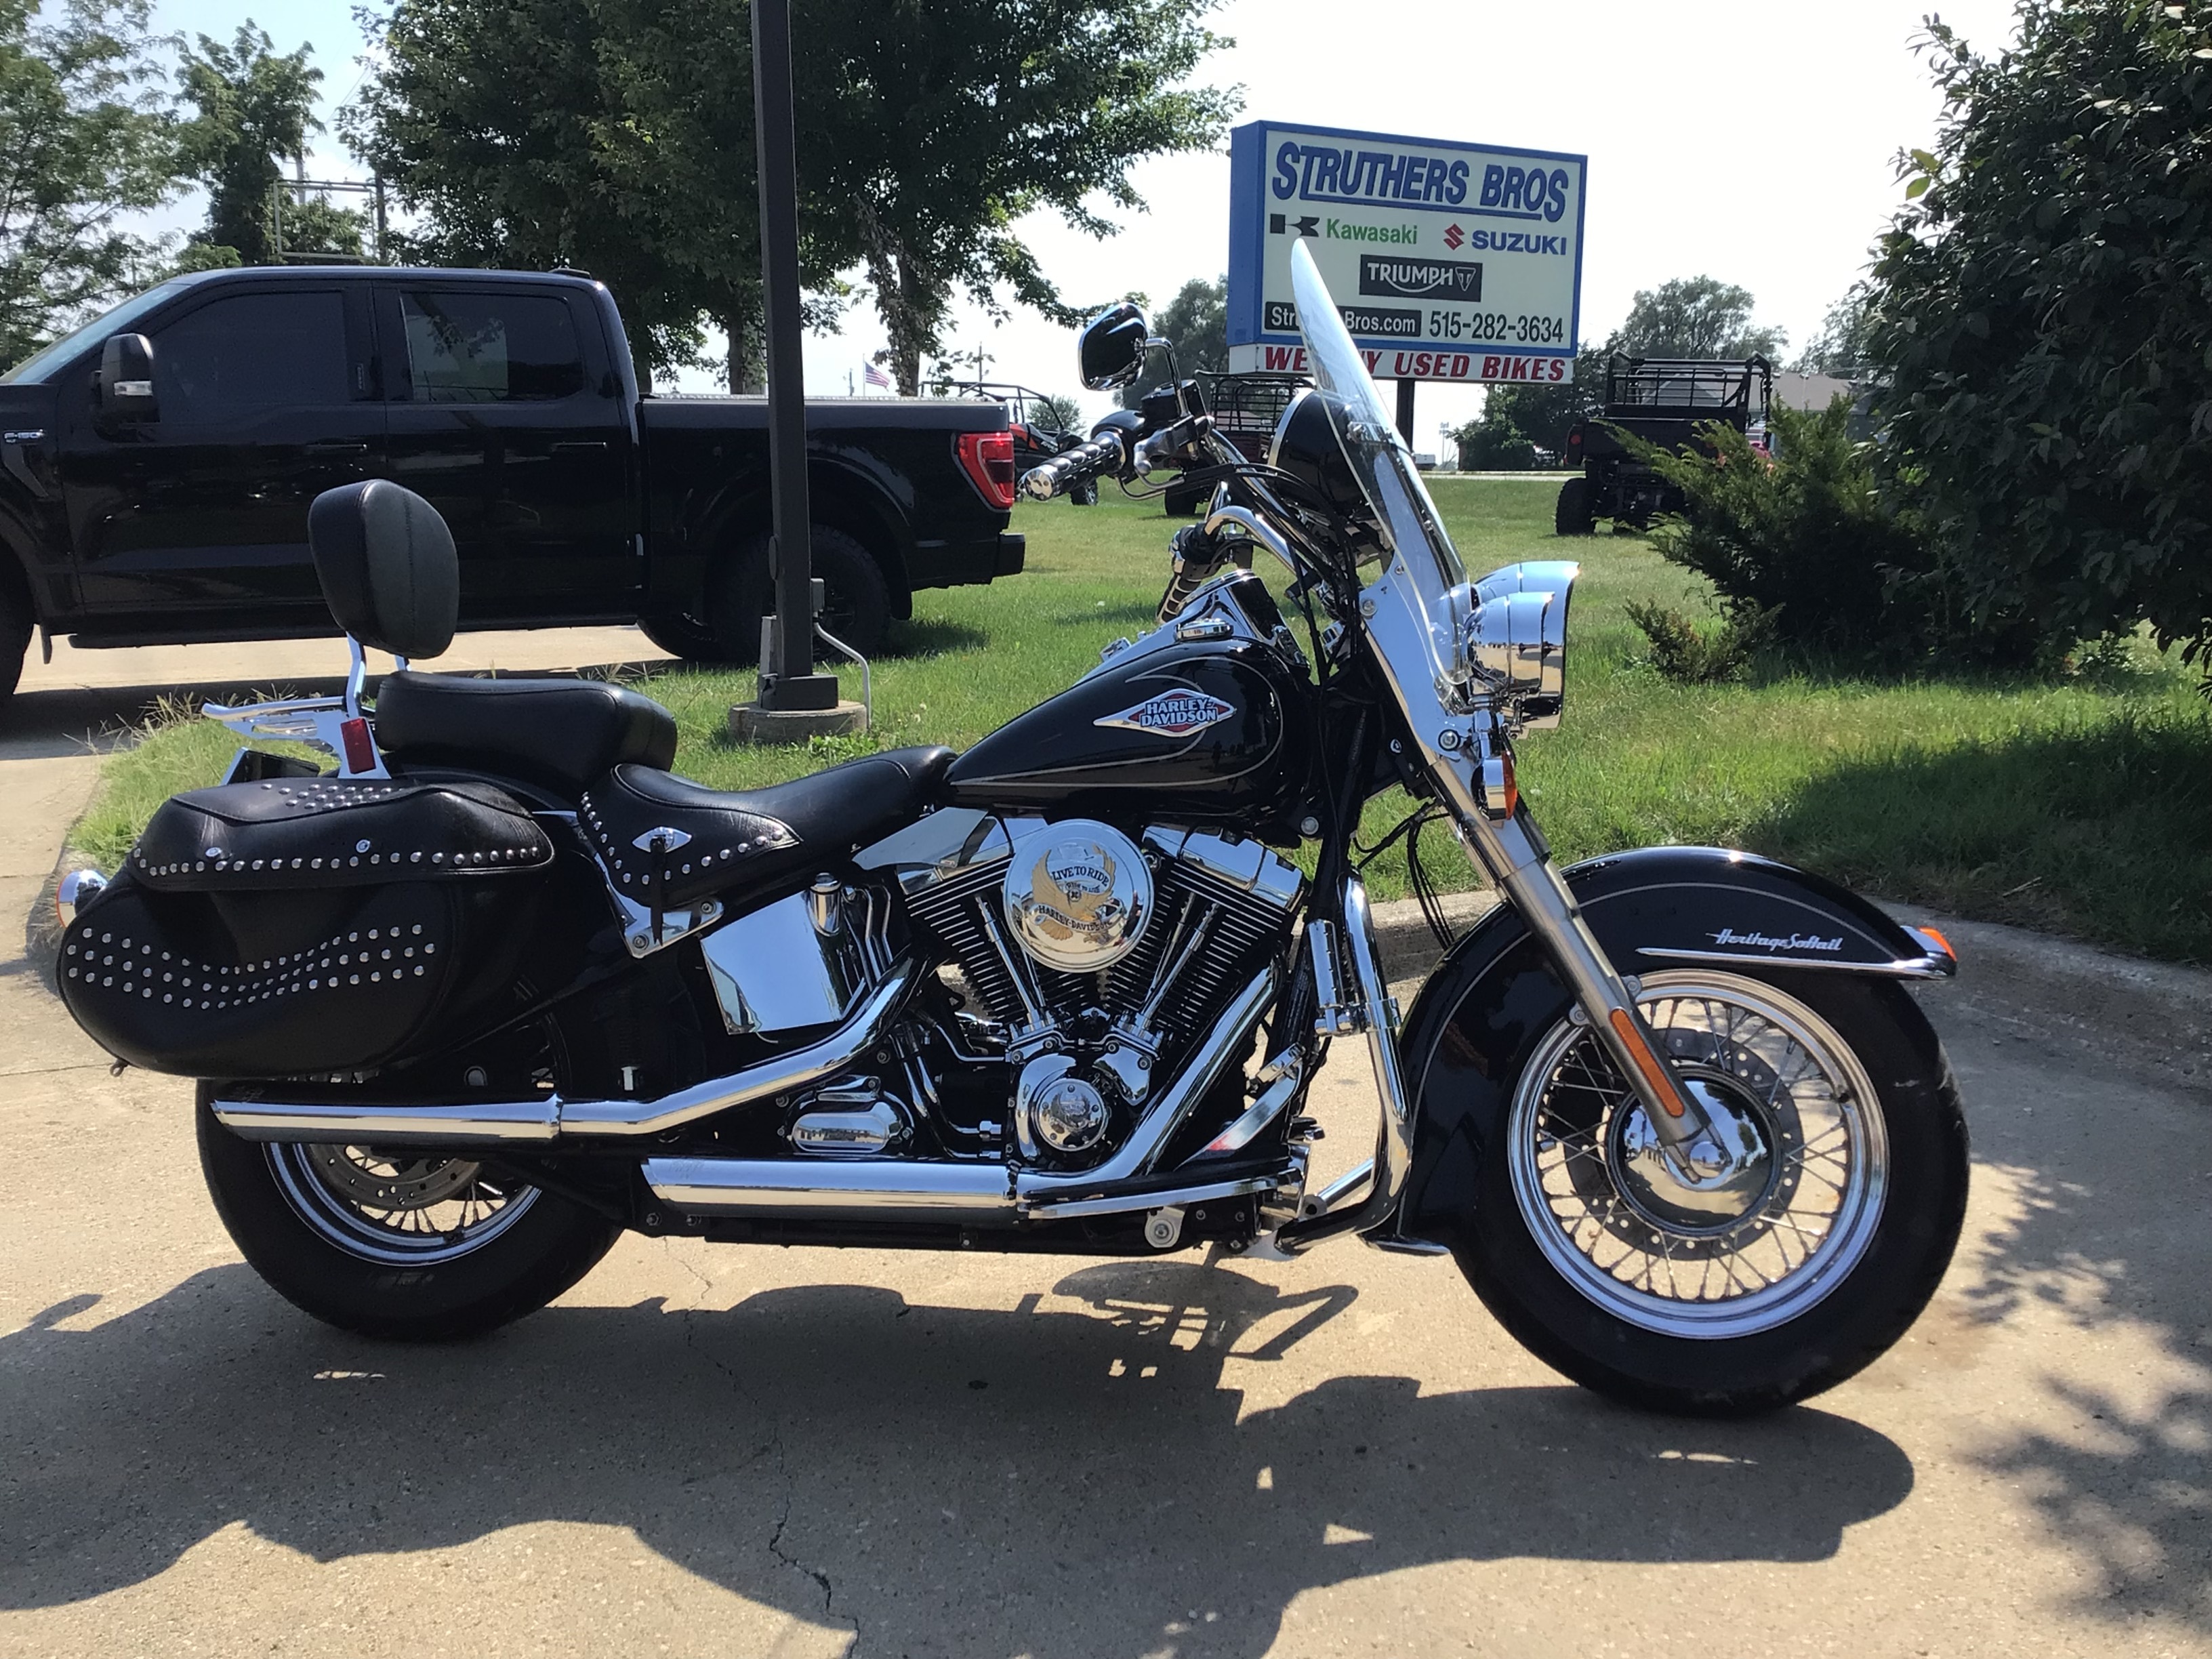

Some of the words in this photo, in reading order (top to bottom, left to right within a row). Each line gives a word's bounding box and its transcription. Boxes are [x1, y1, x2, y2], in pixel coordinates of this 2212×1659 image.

[1273, 141, 1469, 204] STRUTHERS
[1479, 164, 1569, 222] BROS
[1326, 218, 1418, 245] Kawasaki
[1471, 229, 1567, 255] SUZUKI
[1367, 262, 1454, 293] TRIUMPH
[1271, 306, 1416, 333] StrBros.com
[1429, 310, 1563, 343] 515-282-3634
[1265, 346, 1308, 371] WE
[1394, 352, 1470, 377] USED
[1481, 356, 1565, 381] BIKES
[1141, 709, 1216, 726] DAVIDSON
[1052, 867, 1074, 880] LIVE
[1074, 865, 1087, 876] TO
[1087, 867, 1109, 887] RIDE
